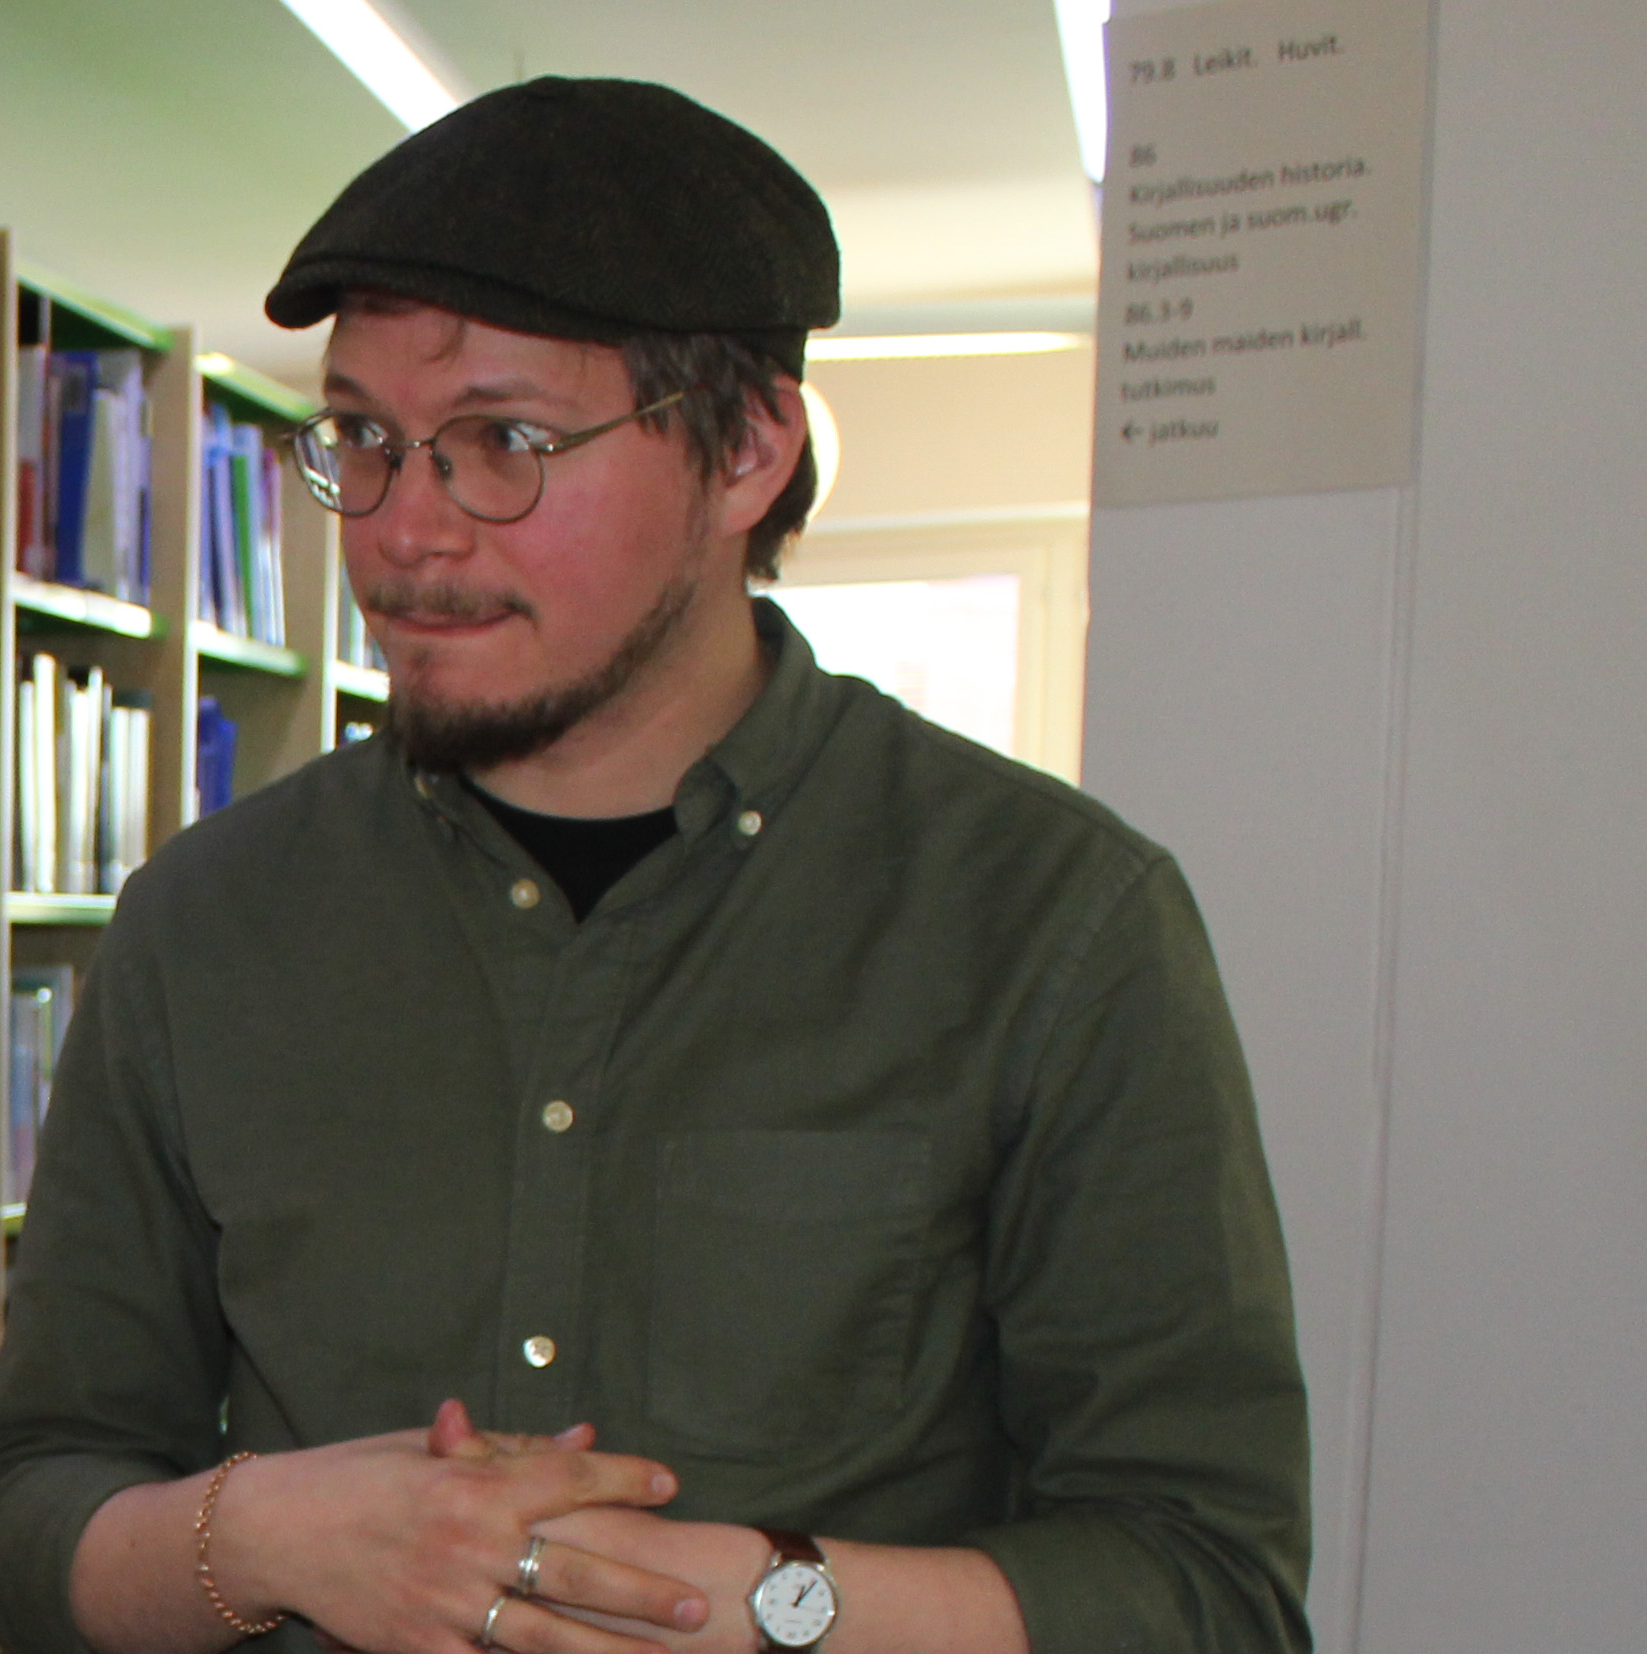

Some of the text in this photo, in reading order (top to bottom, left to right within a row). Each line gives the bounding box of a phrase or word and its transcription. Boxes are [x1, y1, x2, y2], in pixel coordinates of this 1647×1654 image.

[1192, 47, 1258, 76] Leikit.
[1276, 34, 1344, 64] Huvit.
[1129, 155, 1371, 207] Kirjallisuuden historia.
[1127, 217, 1216, 246] Suomen
[1219, 210, 1241, 239] ja
[1125, 253, 1241, 284] kirjallisuus
[1121, 337, 1207, 364] Muiden
[1211, 329, 1294, 356] maiden
[1119, 377, 1216, 403] tutkimus
[1147, 419, 1219, 447] jatkuu
